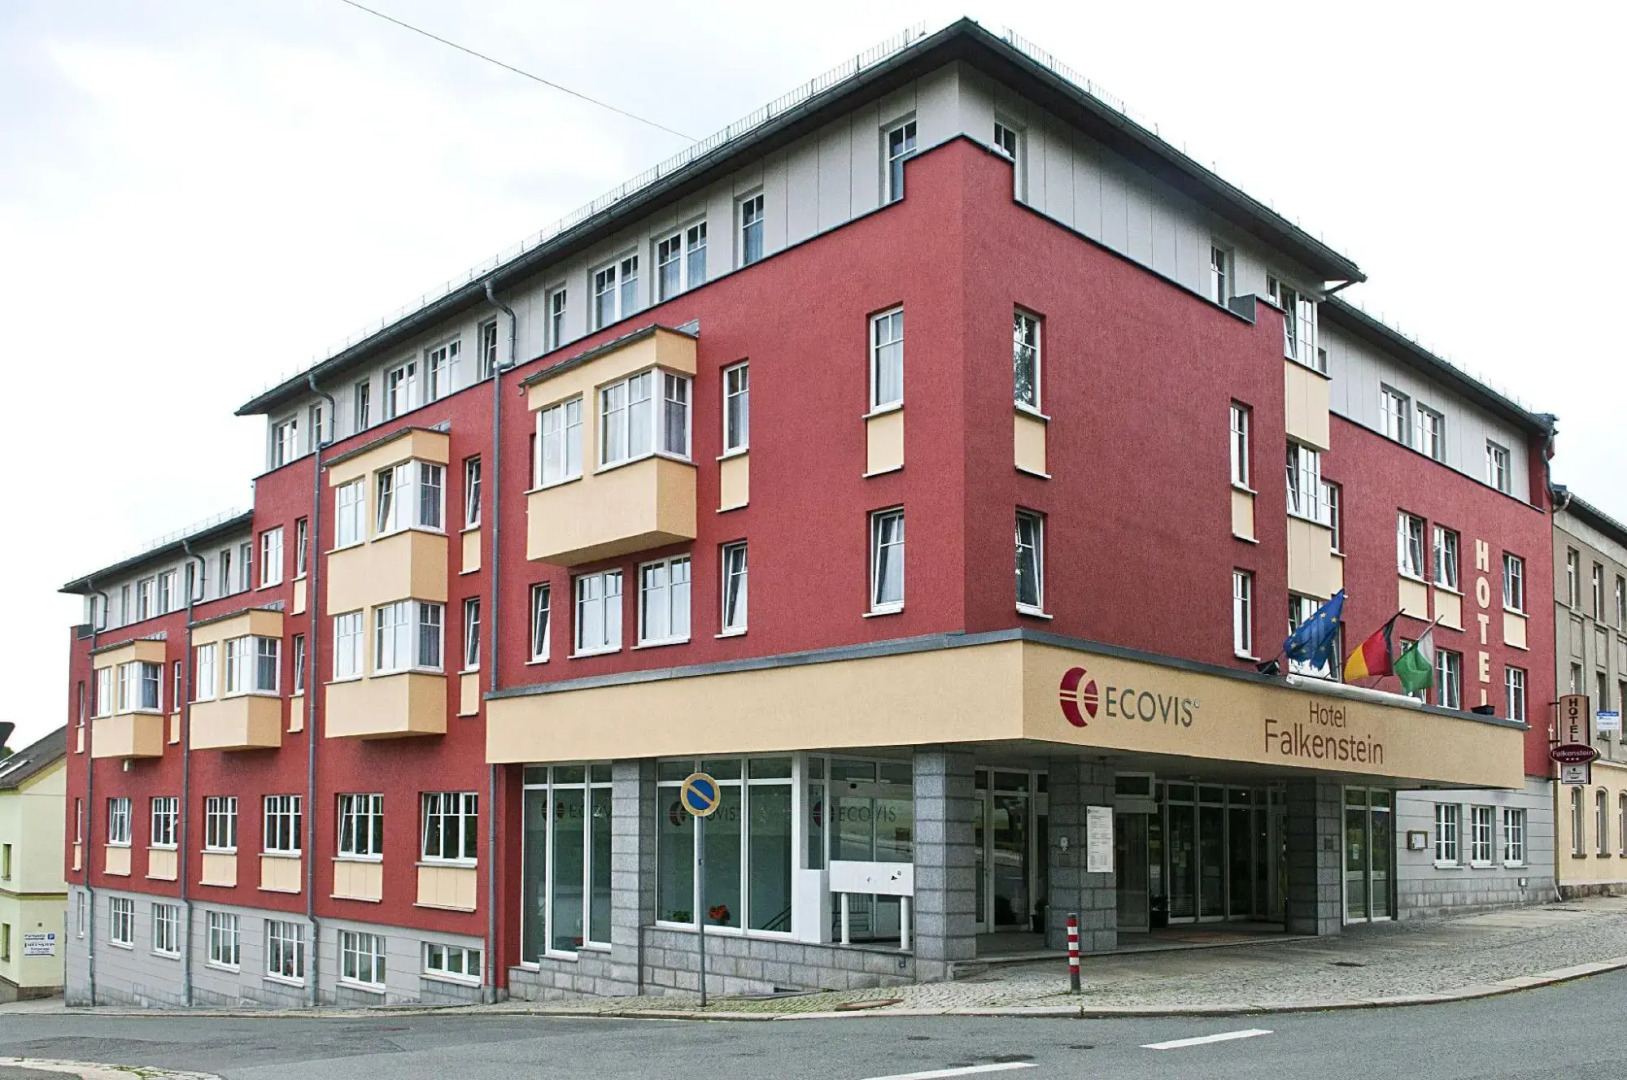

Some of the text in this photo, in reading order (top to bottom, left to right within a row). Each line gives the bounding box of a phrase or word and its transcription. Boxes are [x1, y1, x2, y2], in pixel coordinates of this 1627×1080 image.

[1105, 686, 1194, 728] ECOVIS
[1309, 700, 1346, 728] Hotel
[1568, 697, 1579, 743] HOTEL
[1264, 718, 1384, 765] Falkenstein
[1552, 749, 1594, 758] Falkenstein
